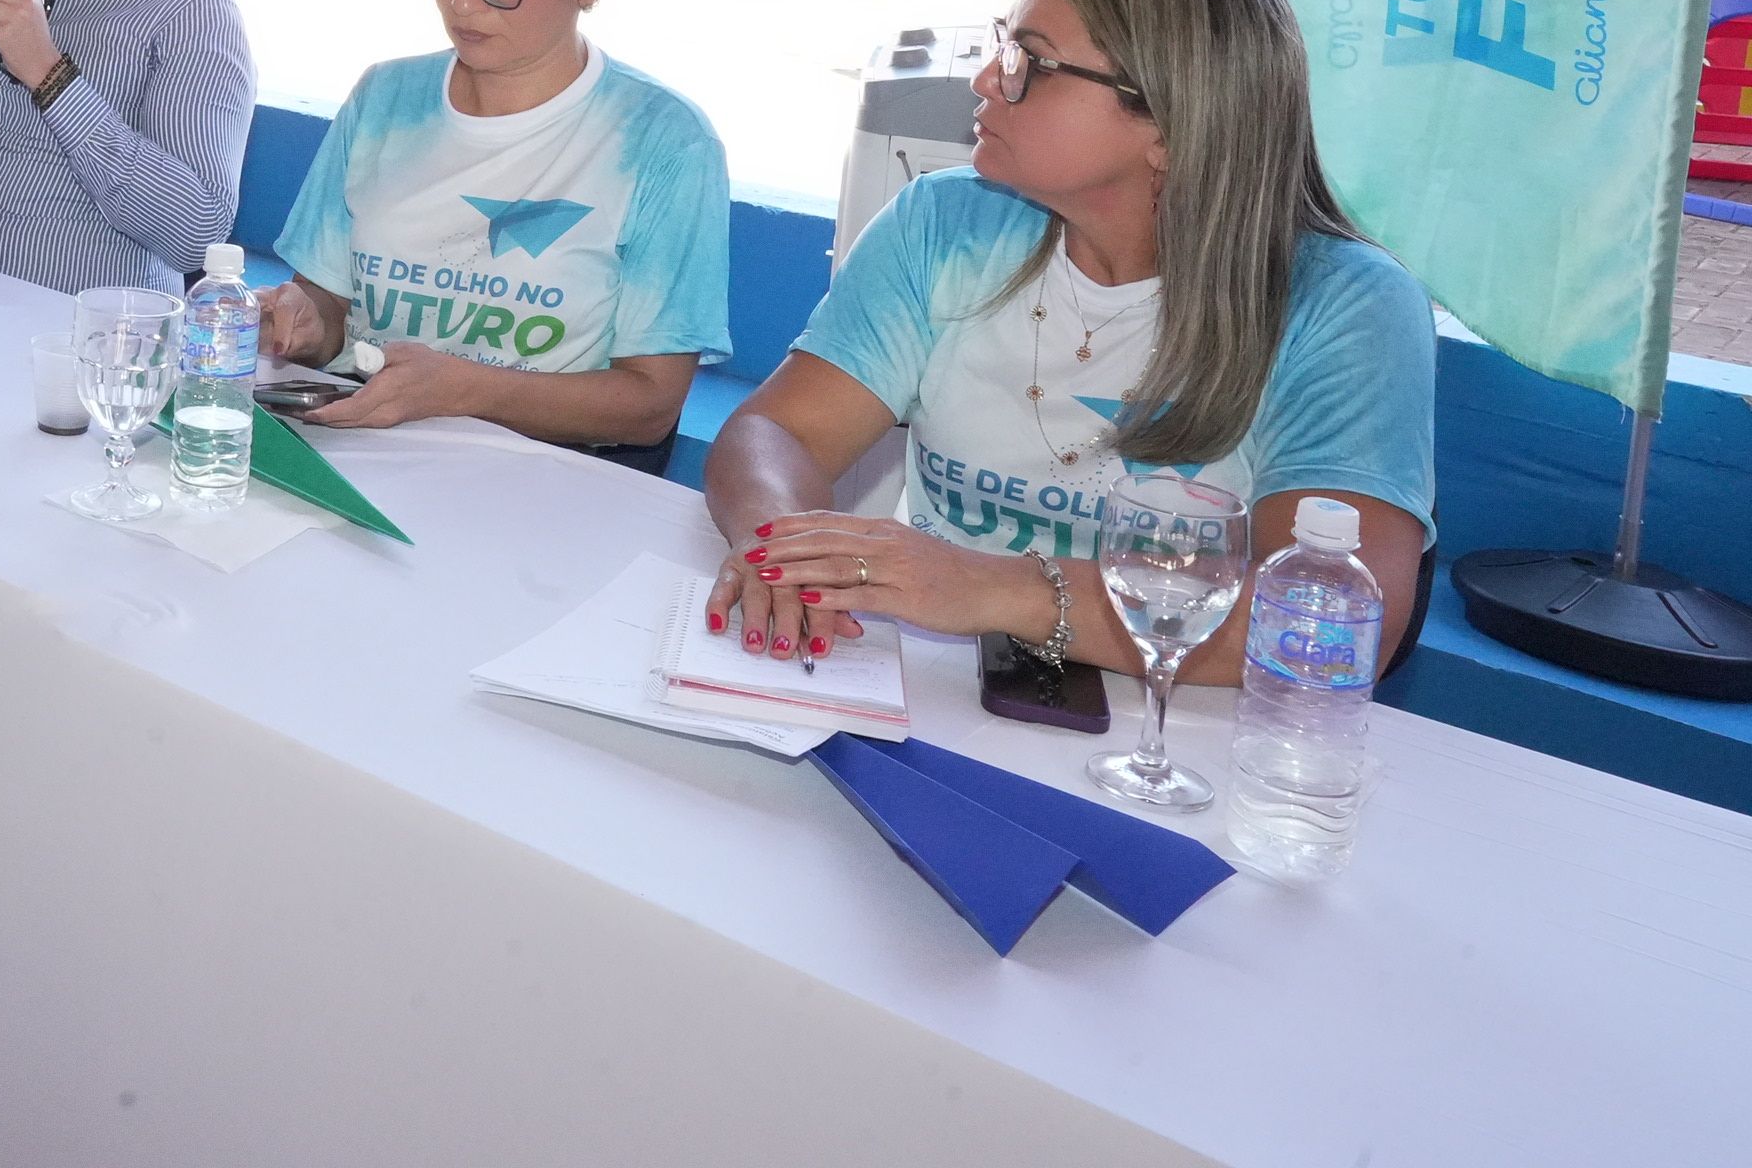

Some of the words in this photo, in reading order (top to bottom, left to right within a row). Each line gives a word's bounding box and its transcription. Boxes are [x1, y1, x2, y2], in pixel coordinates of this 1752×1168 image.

[388, 259, 427, 285] DE
[434, 268, 508, 298] OLHO
[515, 282, 564, 308] NO
[918, 442, 966, 485] TCE
[976, 469, 1028, 503] DE
[1279, 631, 1356, 666] Clara
